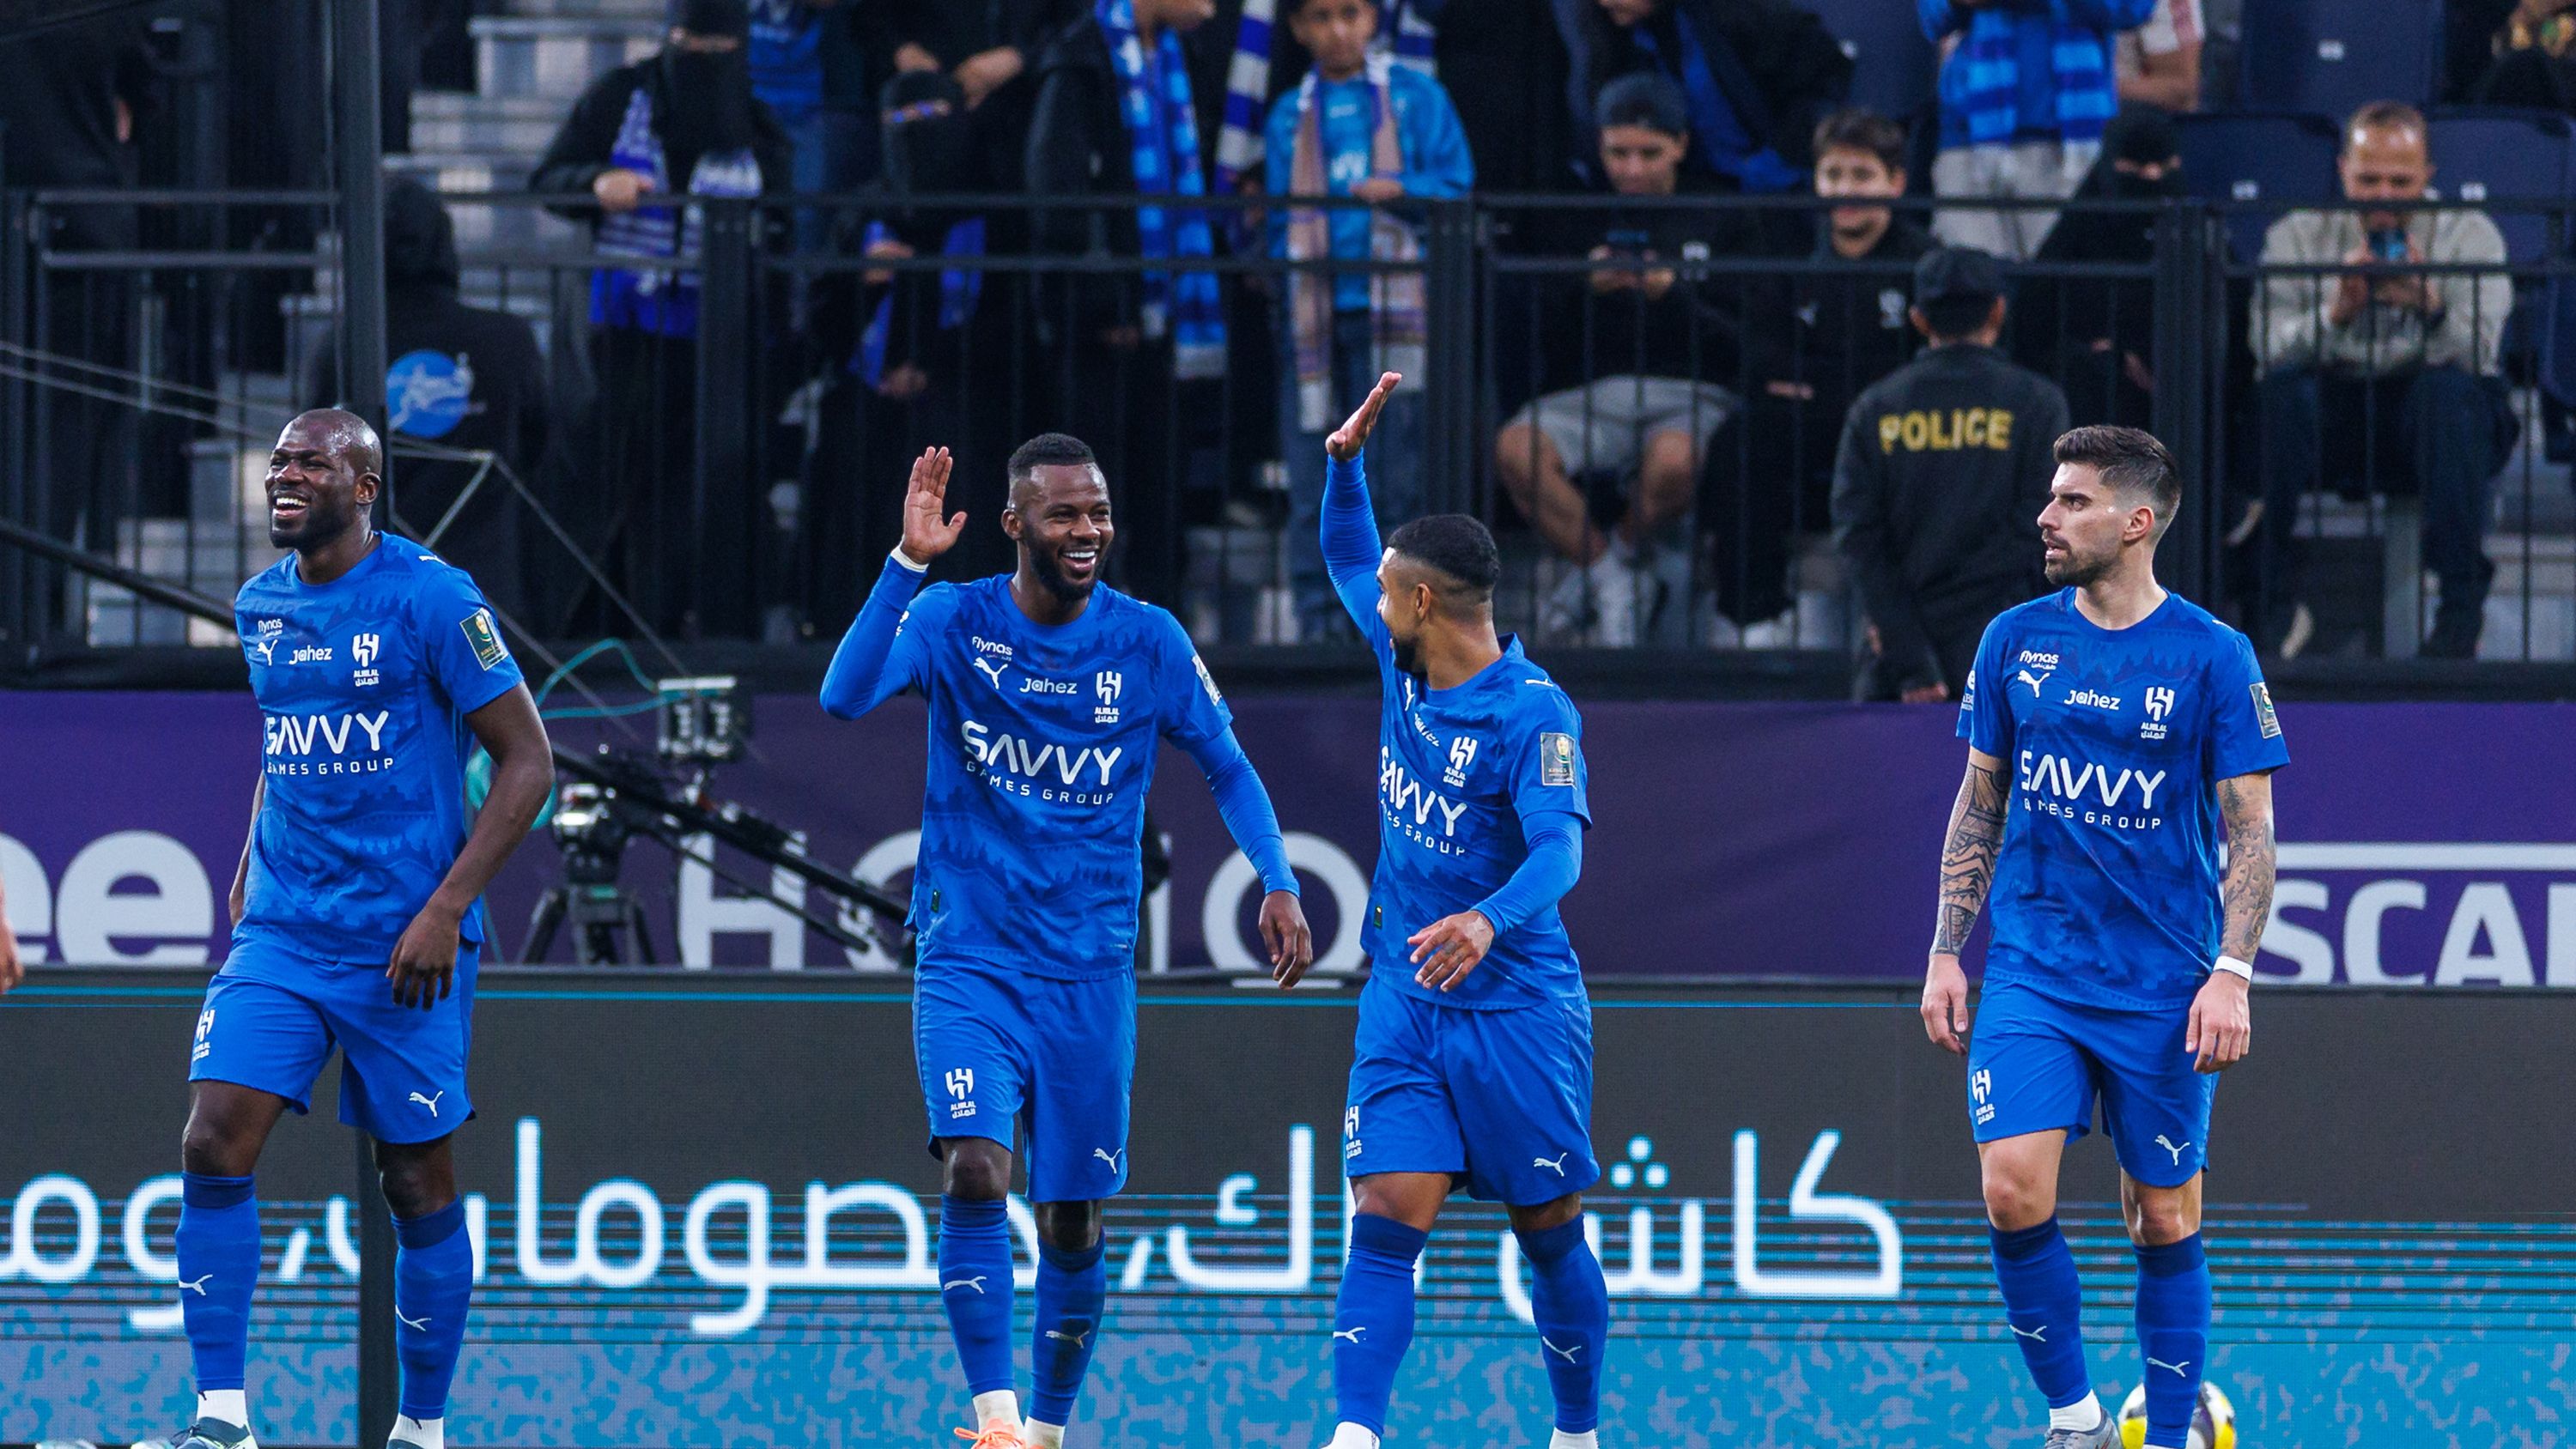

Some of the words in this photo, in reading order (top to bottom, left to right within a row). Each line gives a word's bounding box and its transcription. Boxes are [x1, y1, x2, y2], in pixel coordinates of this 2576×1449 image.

[1879, 407, 2014, 454] POLICE
[972, 636, 1013, 657] flynas
[2019, 650, 2059, 665] flynas
[265, 710, 389, 755] SAVVY
[961, 720, 1122, 786] SAVVY
[318, 757, 393, 775] GROUP
[966, 761, 1030, 797] GAMES
[1042, 788, 1114, 805] GROUP
[2020, 749, 2166, 809] SAVVY
[2084, 811, 2161, 830] GROUP
